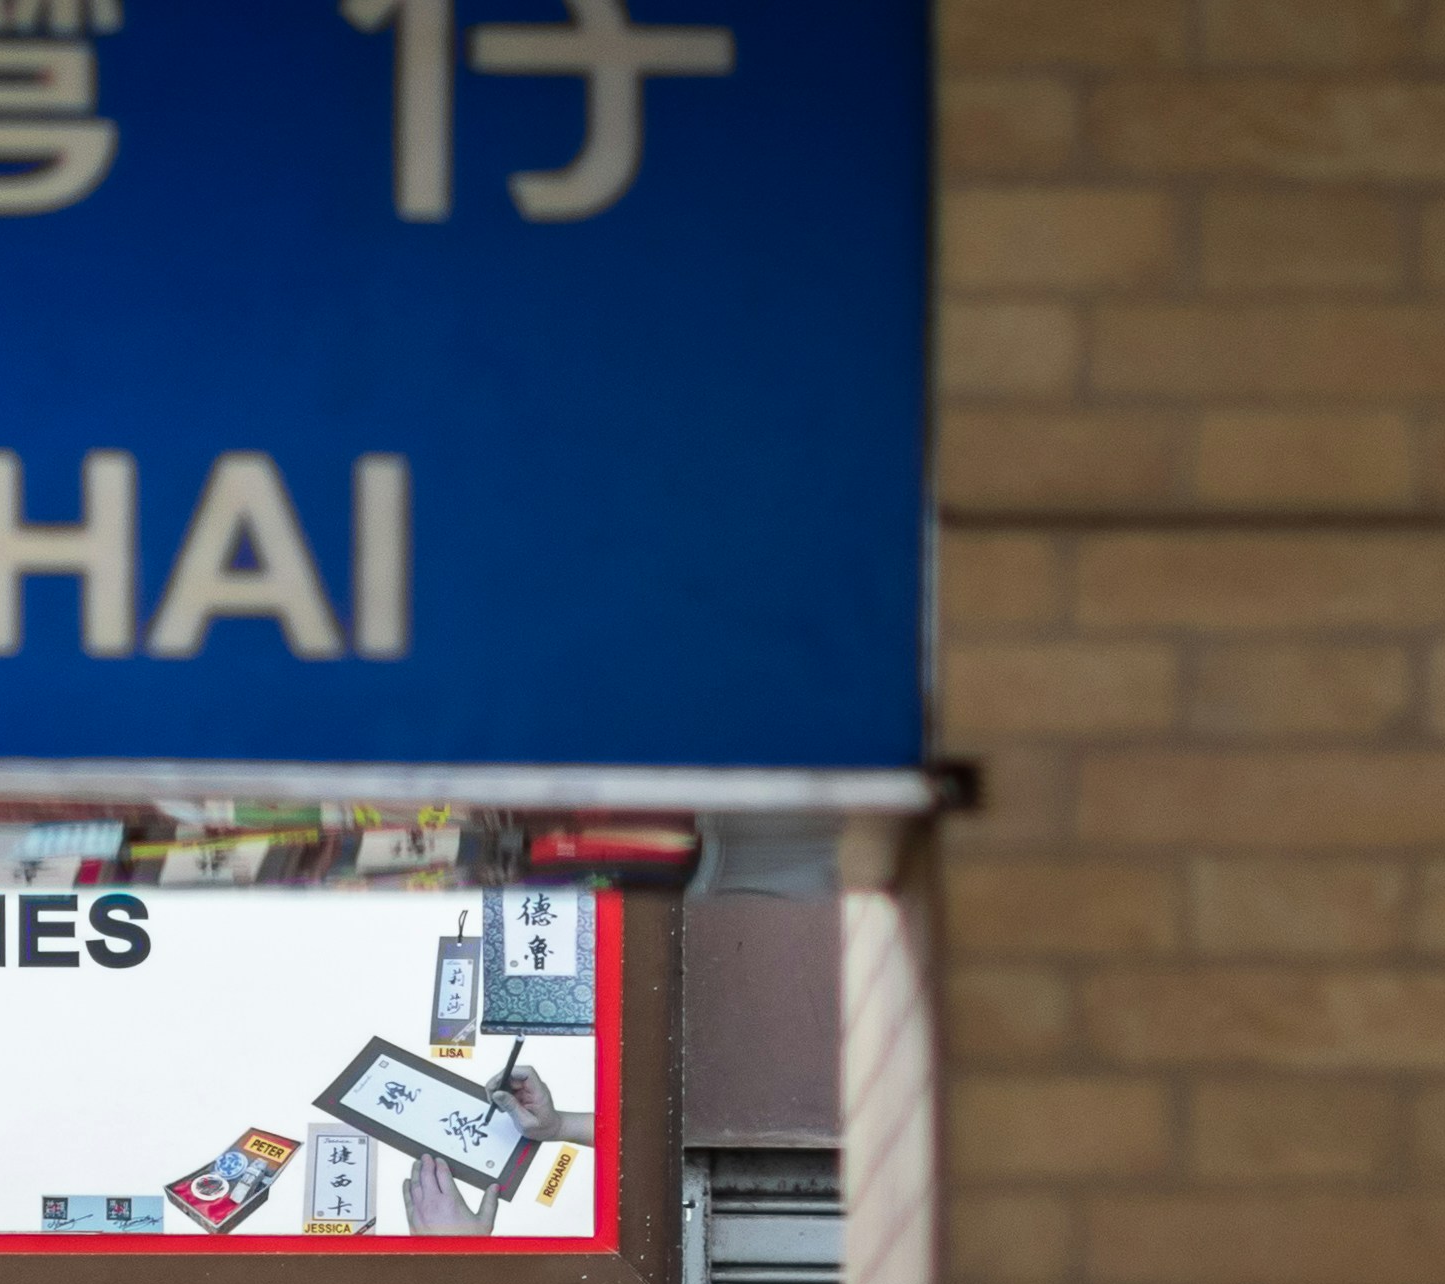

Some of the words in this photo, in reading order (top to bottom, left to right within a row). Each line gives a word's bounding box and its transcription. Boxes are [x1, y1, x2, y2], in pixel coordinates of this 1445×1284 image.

[439, 1048, 465, 1059] LISA
[249, 1138, 286, 1160] PETER
[542, 1152, 572, 1201] RICHARD
[304, 1223, 352, 1234] JESSICA
